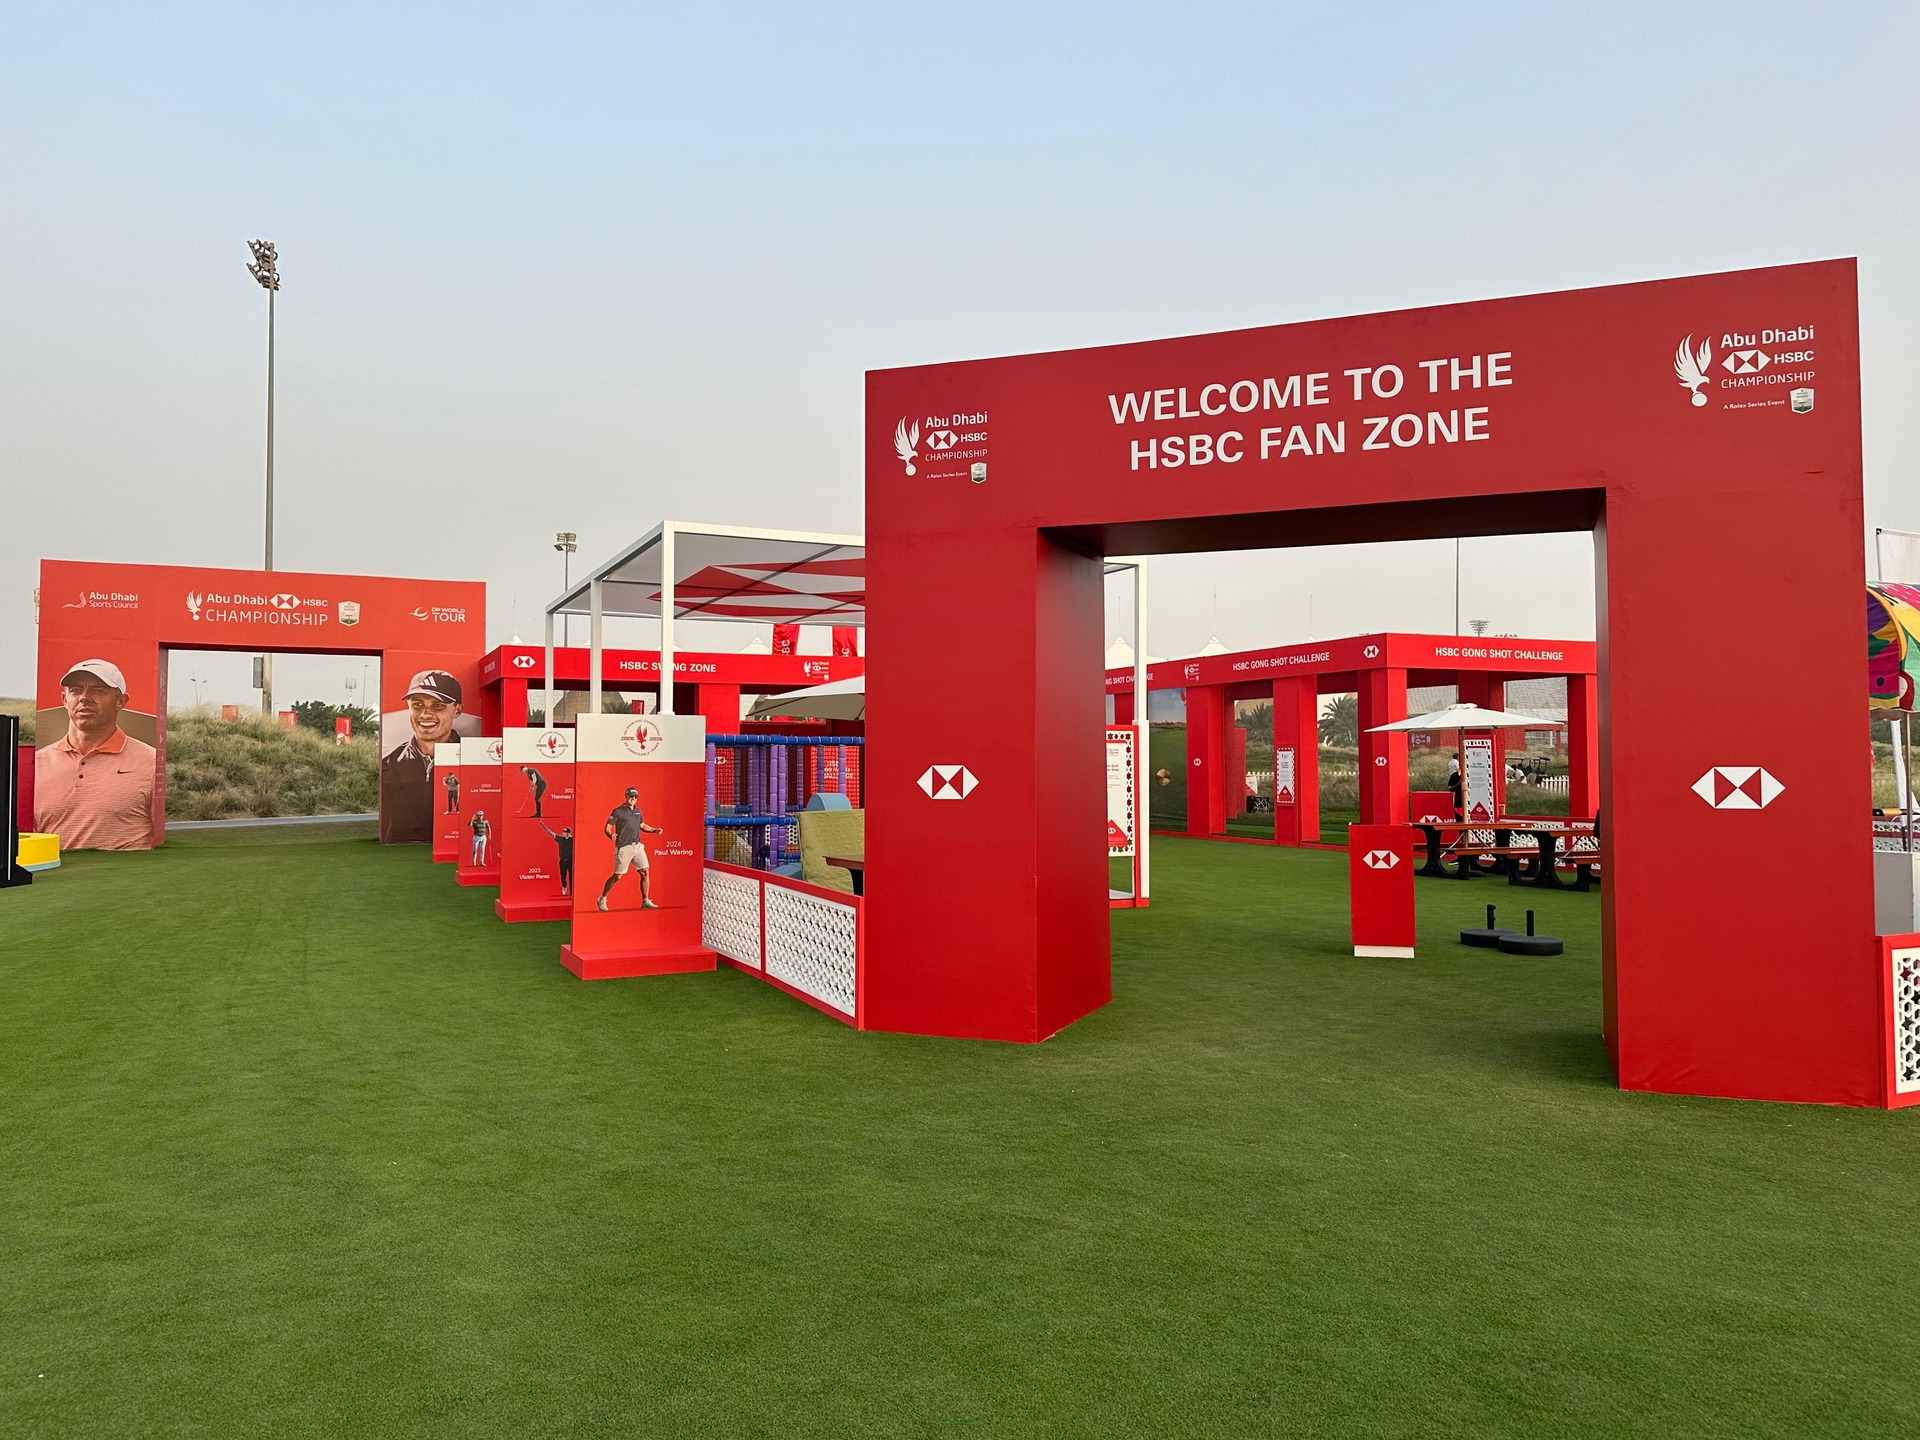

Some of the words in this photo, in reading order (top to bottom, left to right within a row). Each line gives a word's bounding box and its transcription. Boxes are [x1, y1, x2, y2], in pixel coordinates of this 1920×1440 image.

[1720, 332, 1756, 348] Abu
[1762, 324, 1814, 344] Dhabi
[1774, 350, 1814, 364] HSBC
[1720, 371, 1816, 388] CHAMPIONSHIP
[1108, 372, 1329, 424] WELCOME
[1344, 364, 1404, 400] TO
[1418, 352, 1512, 393] THE
[925, 416, 949, 428] Abu
[953, 411, 988, 426] Dhabi
[961, 432, 988, 442] HSBC
[1130, 430, 1244, 470] HSBC
[1260, 420, 1346, 460] FAN
[1362, 406, 1490, 450] ZONE
[925, 448, 988, 462] CHAMPIONSHIP
[89, 592, 108, 600] Abu
[111, 592, 138, 602] Dhabi
[206, 593, 230, 604] Abu
[234, 594, 268, 605] Dhabi
[303, 599, 328, 607] HSBC
[206, 609, 328, 626] CHAMPIONSHIP
[432, 612, 466, 622] TOUR
[782, 640, 790, 655] BC
[1435, 647, 1459, 656] HSBC
[1462, 648, 1487, 658] GONG
[1490, 649, 1512, 658] SHOT
[1514, 650, 1563, 660] CHALLENGE
[620, 661, 648, 670] HSBC
[690, 664, 716, 672] ZONE
[1233, 662, 1249, 671] HSBC
[1251, 660, 1268, 669] GONG
[1270, 657, 1288, 666] SHOT
[1289, 652, 1330, 664] CHALLENGE
